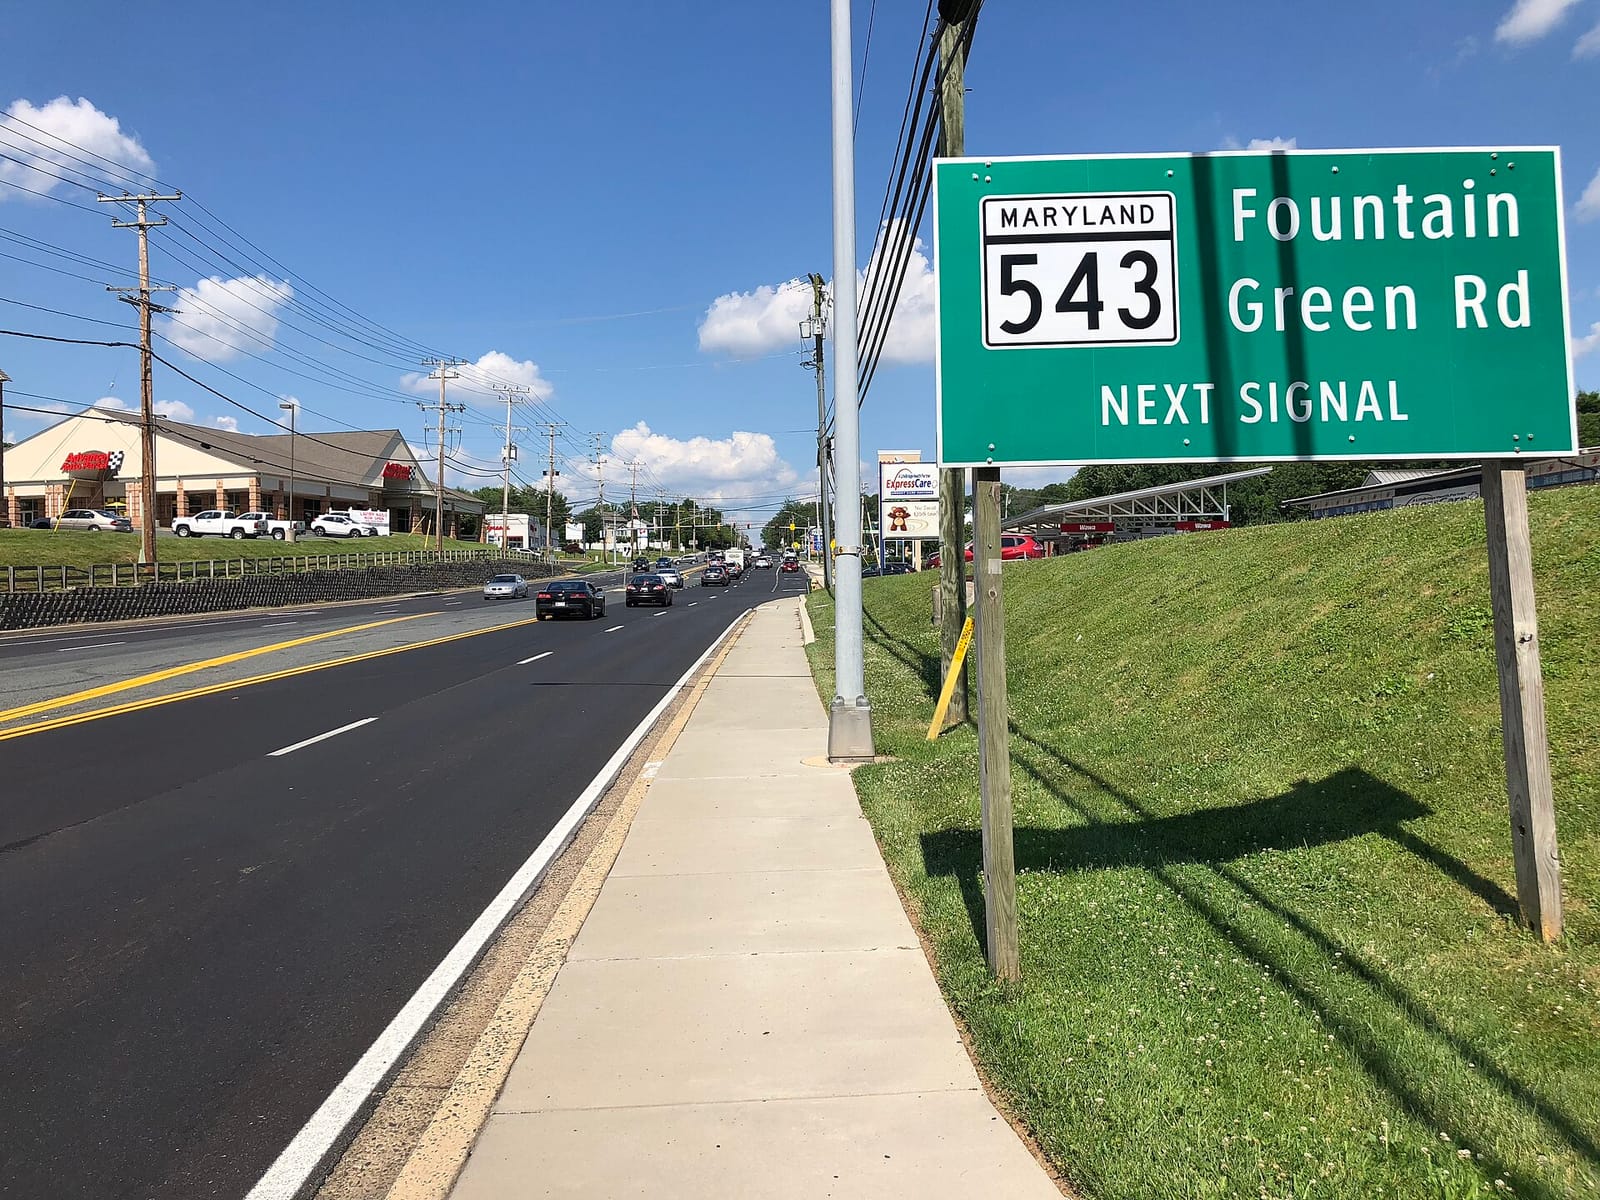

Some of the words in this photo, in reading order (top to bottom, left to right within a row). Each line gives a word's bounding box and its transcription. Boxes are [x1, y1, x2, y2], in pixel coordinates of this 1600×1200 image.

[1001, 204, 1155, 228] MARYLAND
[1231, 178, 1521, 242] Fountain
[999, 249, 1162, 335] 543
[1228, 277, 1418, 333] Green
[1453, 269, 1532, 330] Rd
[1100, 382, 1216, 426] NEXT
[1239, 380, 1410, 424] SIGNAL
[886, 478, 932, 491] ExpressCare
